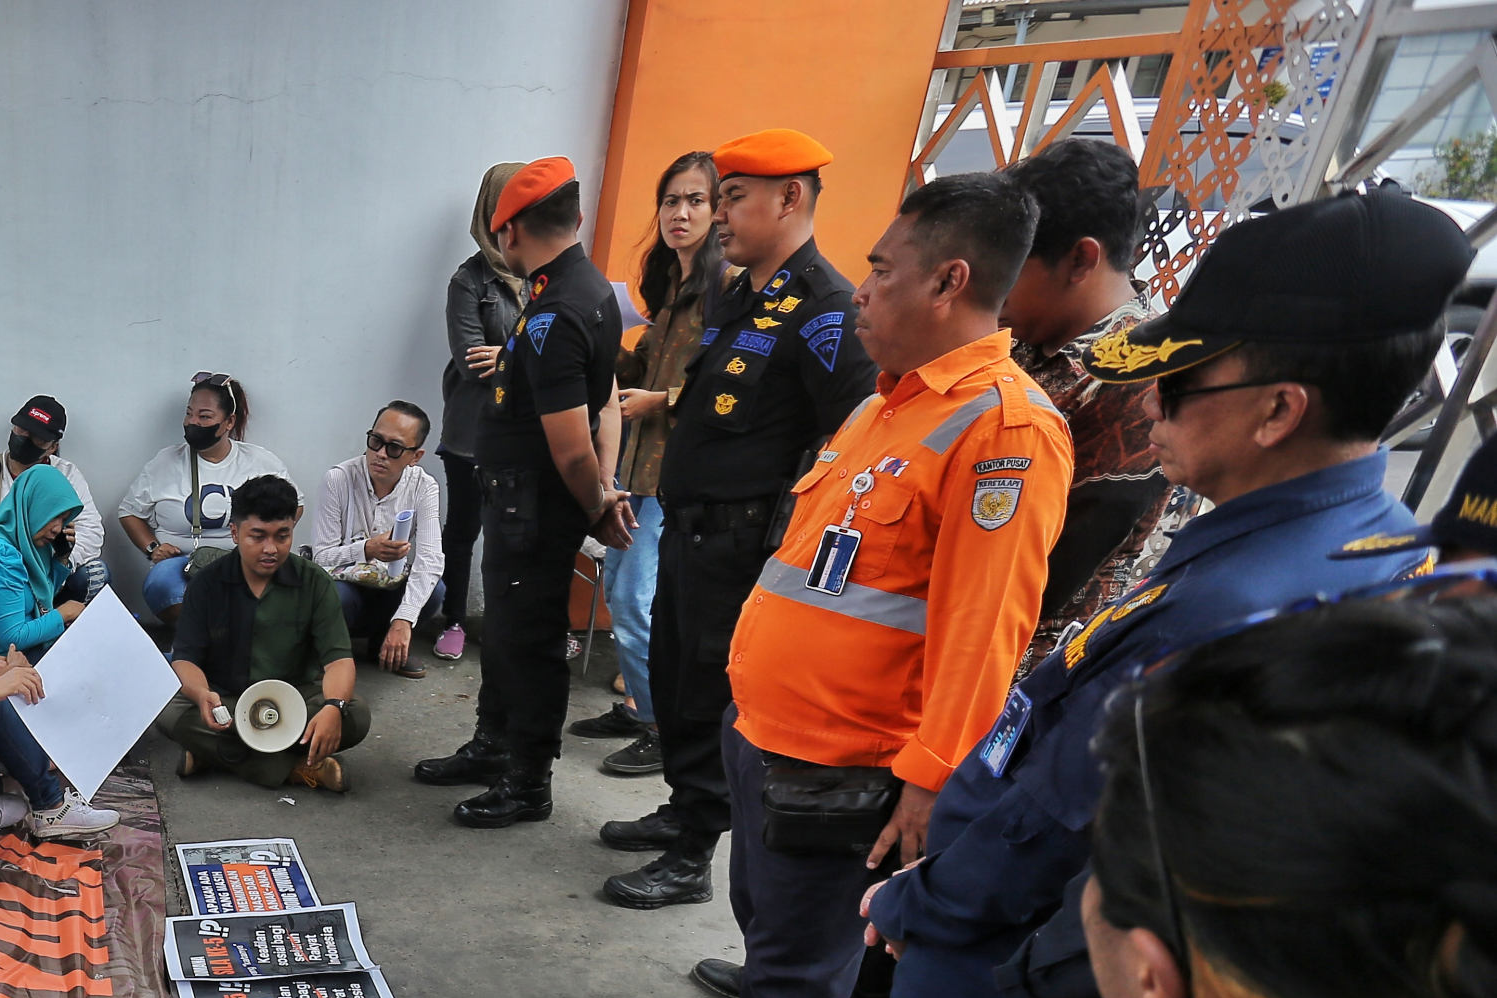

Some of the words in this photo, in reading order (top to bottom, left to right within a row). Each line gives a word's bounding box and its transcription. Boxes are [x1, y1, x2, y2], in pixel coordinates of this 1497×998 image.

[977, 459, 1005, 472] KANTOR
[1006, 459, 1028, 468] PUSAT
[197, 870, 212, 885] ADA
[211, 871, 228, 892] MASIH
[243, 875, 258, 890] DARI
[271, 867, 295, 893] SUWUNG
[202, 885, 220, 914] APAKAH
[226, 870, 250, 912] MEMIKIRKAN
[249, 889, 266, 912] NASIB
[254, 869, 280, 911] ANAK-ANAK
[218, 891, 234, 913] YANG
[268, 925, 286, 943] bagi
[320, 926, 341, 965] Indonesia
[203, 937, 229, 957] KE-5
[253, 930, 271, 964] Keadilan
[273, 942, 288, 966] sosial
[304, 934, 322, 962] Rakyat
[209, 958, 235, 976] SILA
